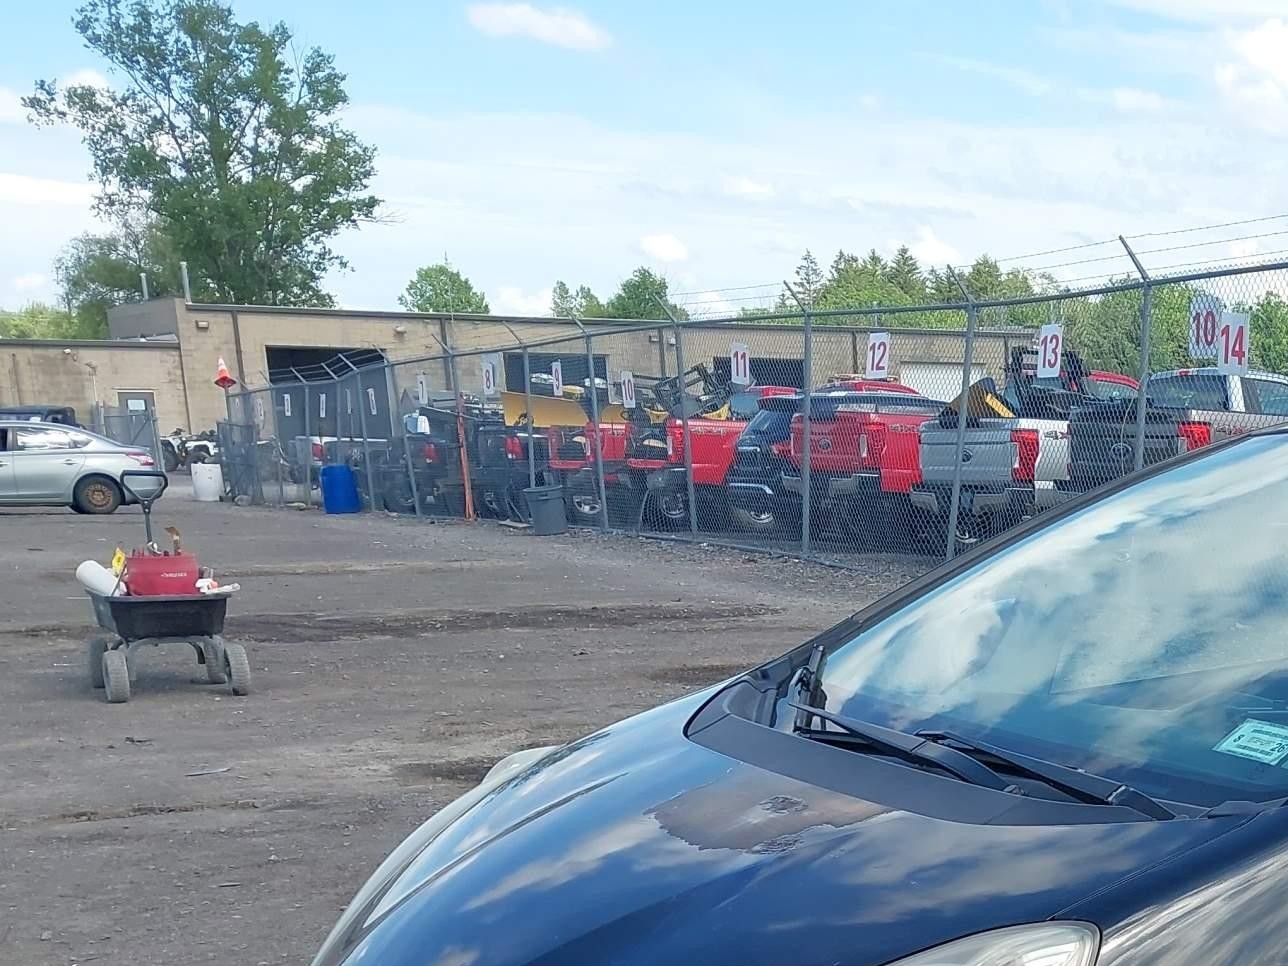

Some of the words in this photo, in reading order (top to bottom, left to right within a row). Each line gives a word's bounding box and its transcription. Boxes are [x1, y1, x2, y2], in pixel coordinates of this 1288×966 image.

[1191, 310, 1216, 347] 10
[868, 341, 887, 371] 12
[1040, 334, 1060, 369] 13
[1220, 324, 1246, 366] 14
[732, 350, 748, 378] 11
[484, 369, 492, 390] 8
[554, 367, 560, 391] 9
[622, 378, 634, 401] 10
